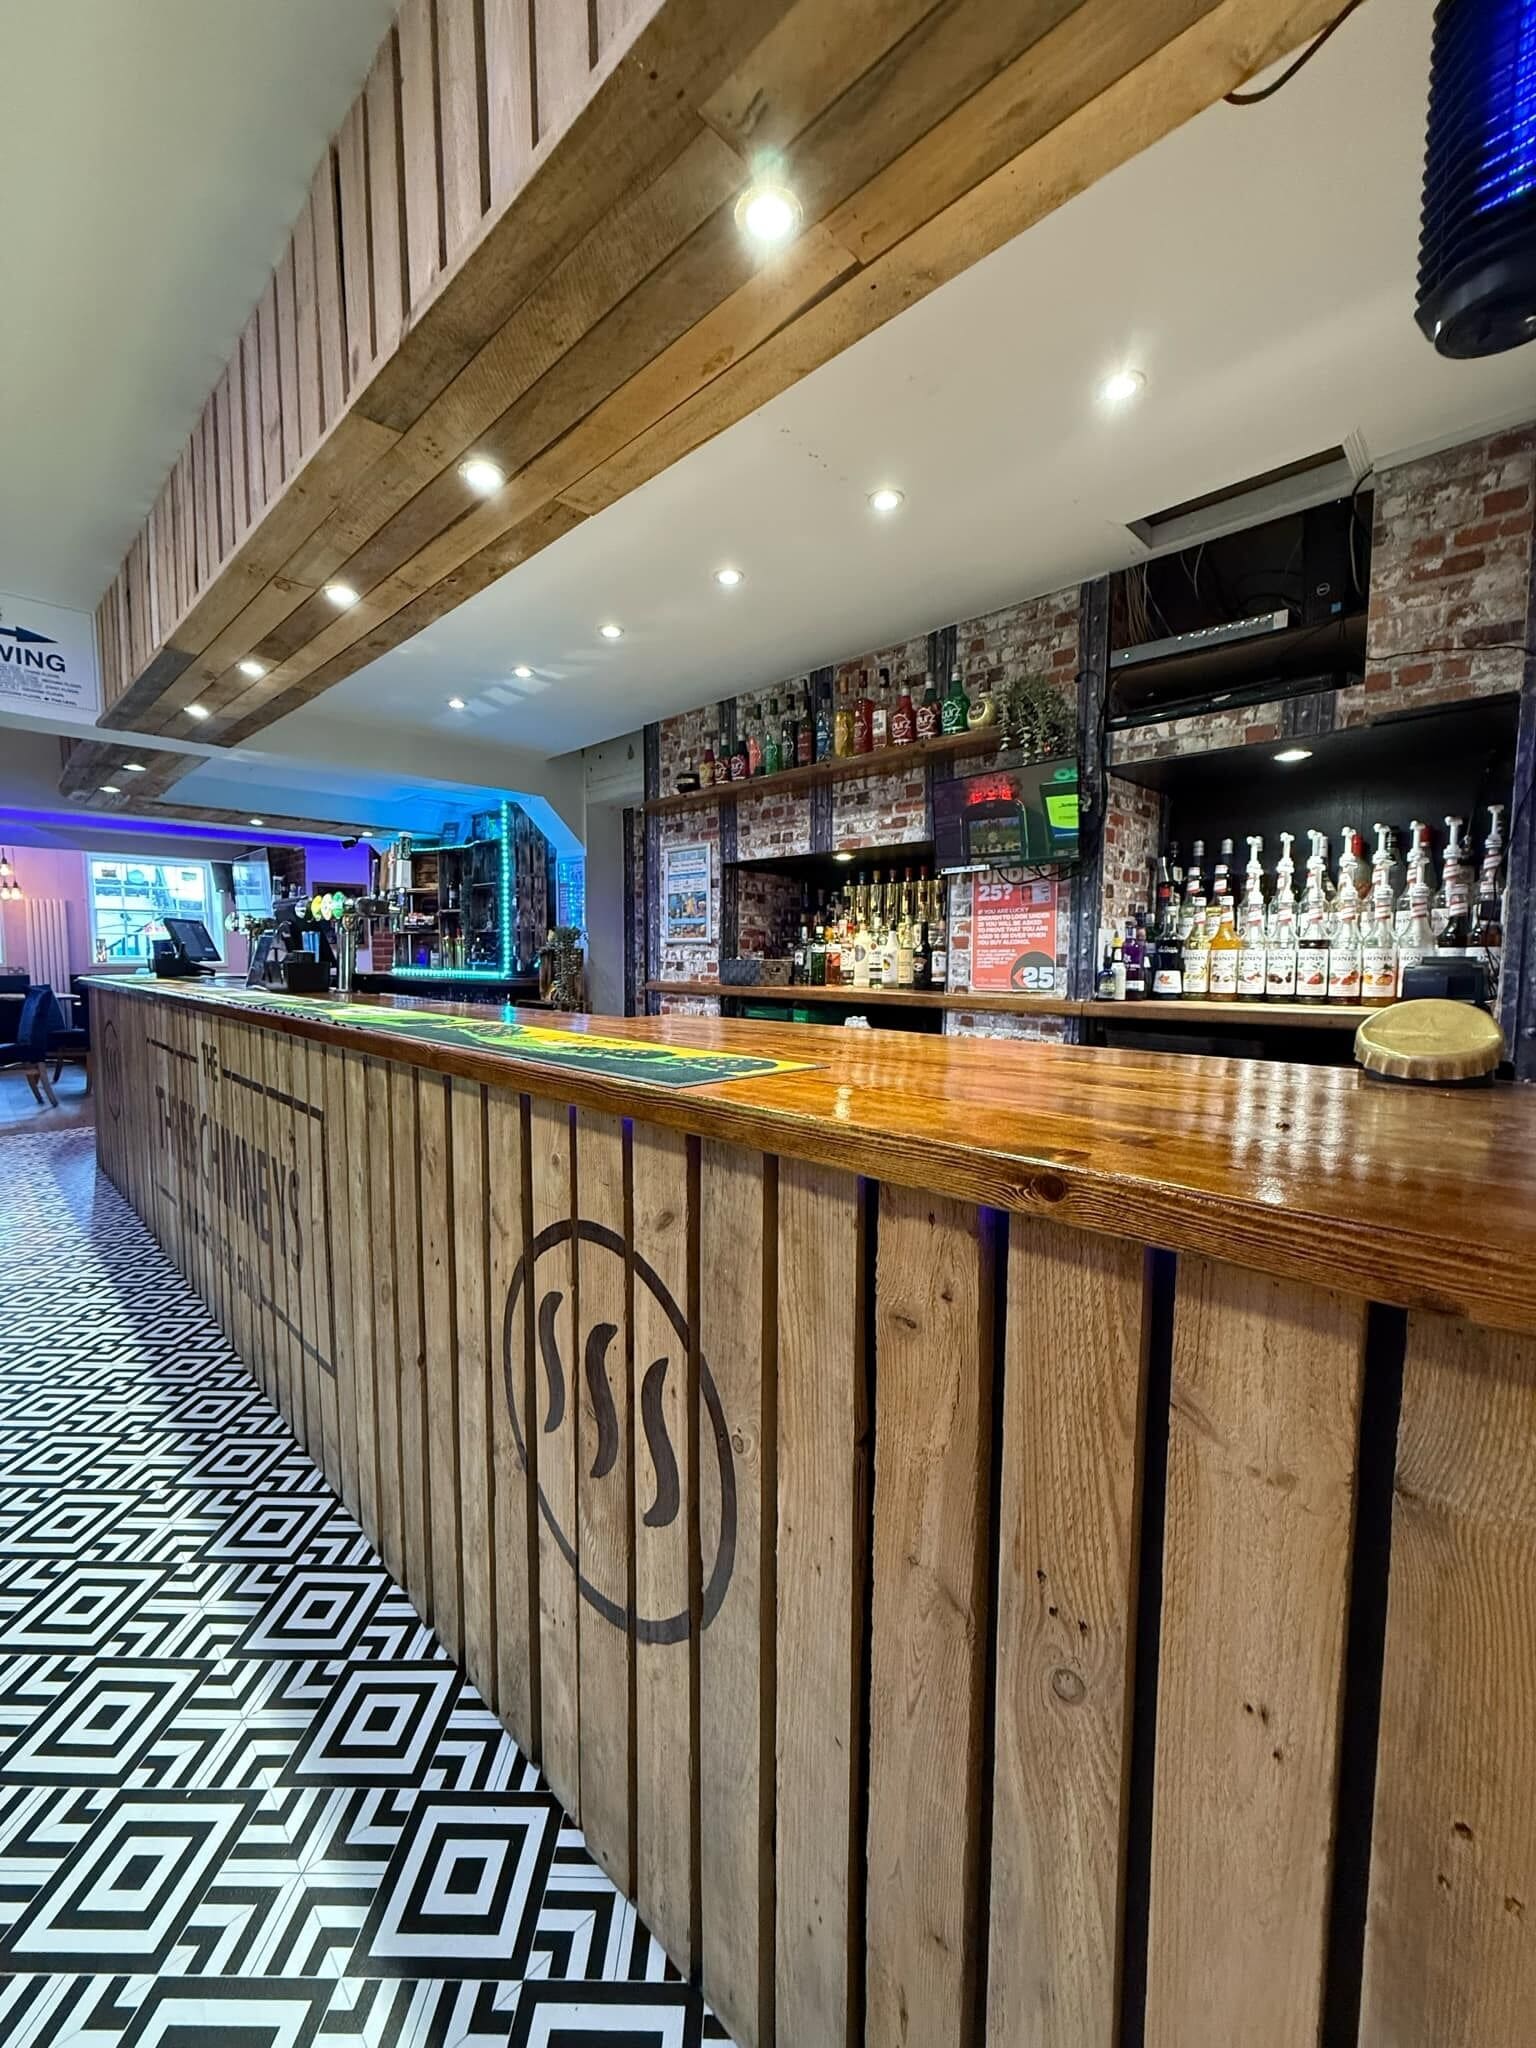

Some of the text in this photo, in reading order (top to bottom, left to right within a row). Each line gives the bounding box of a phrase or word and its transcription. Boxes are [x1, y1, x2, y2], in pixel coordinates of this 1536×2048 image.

[979, 884, 1013, 901] 25?
[1023, 966, 1054, 988] 25
[201, 1041, 219, 1083] THE
[201, 1113, 304, 1274] CHIMNEYS
